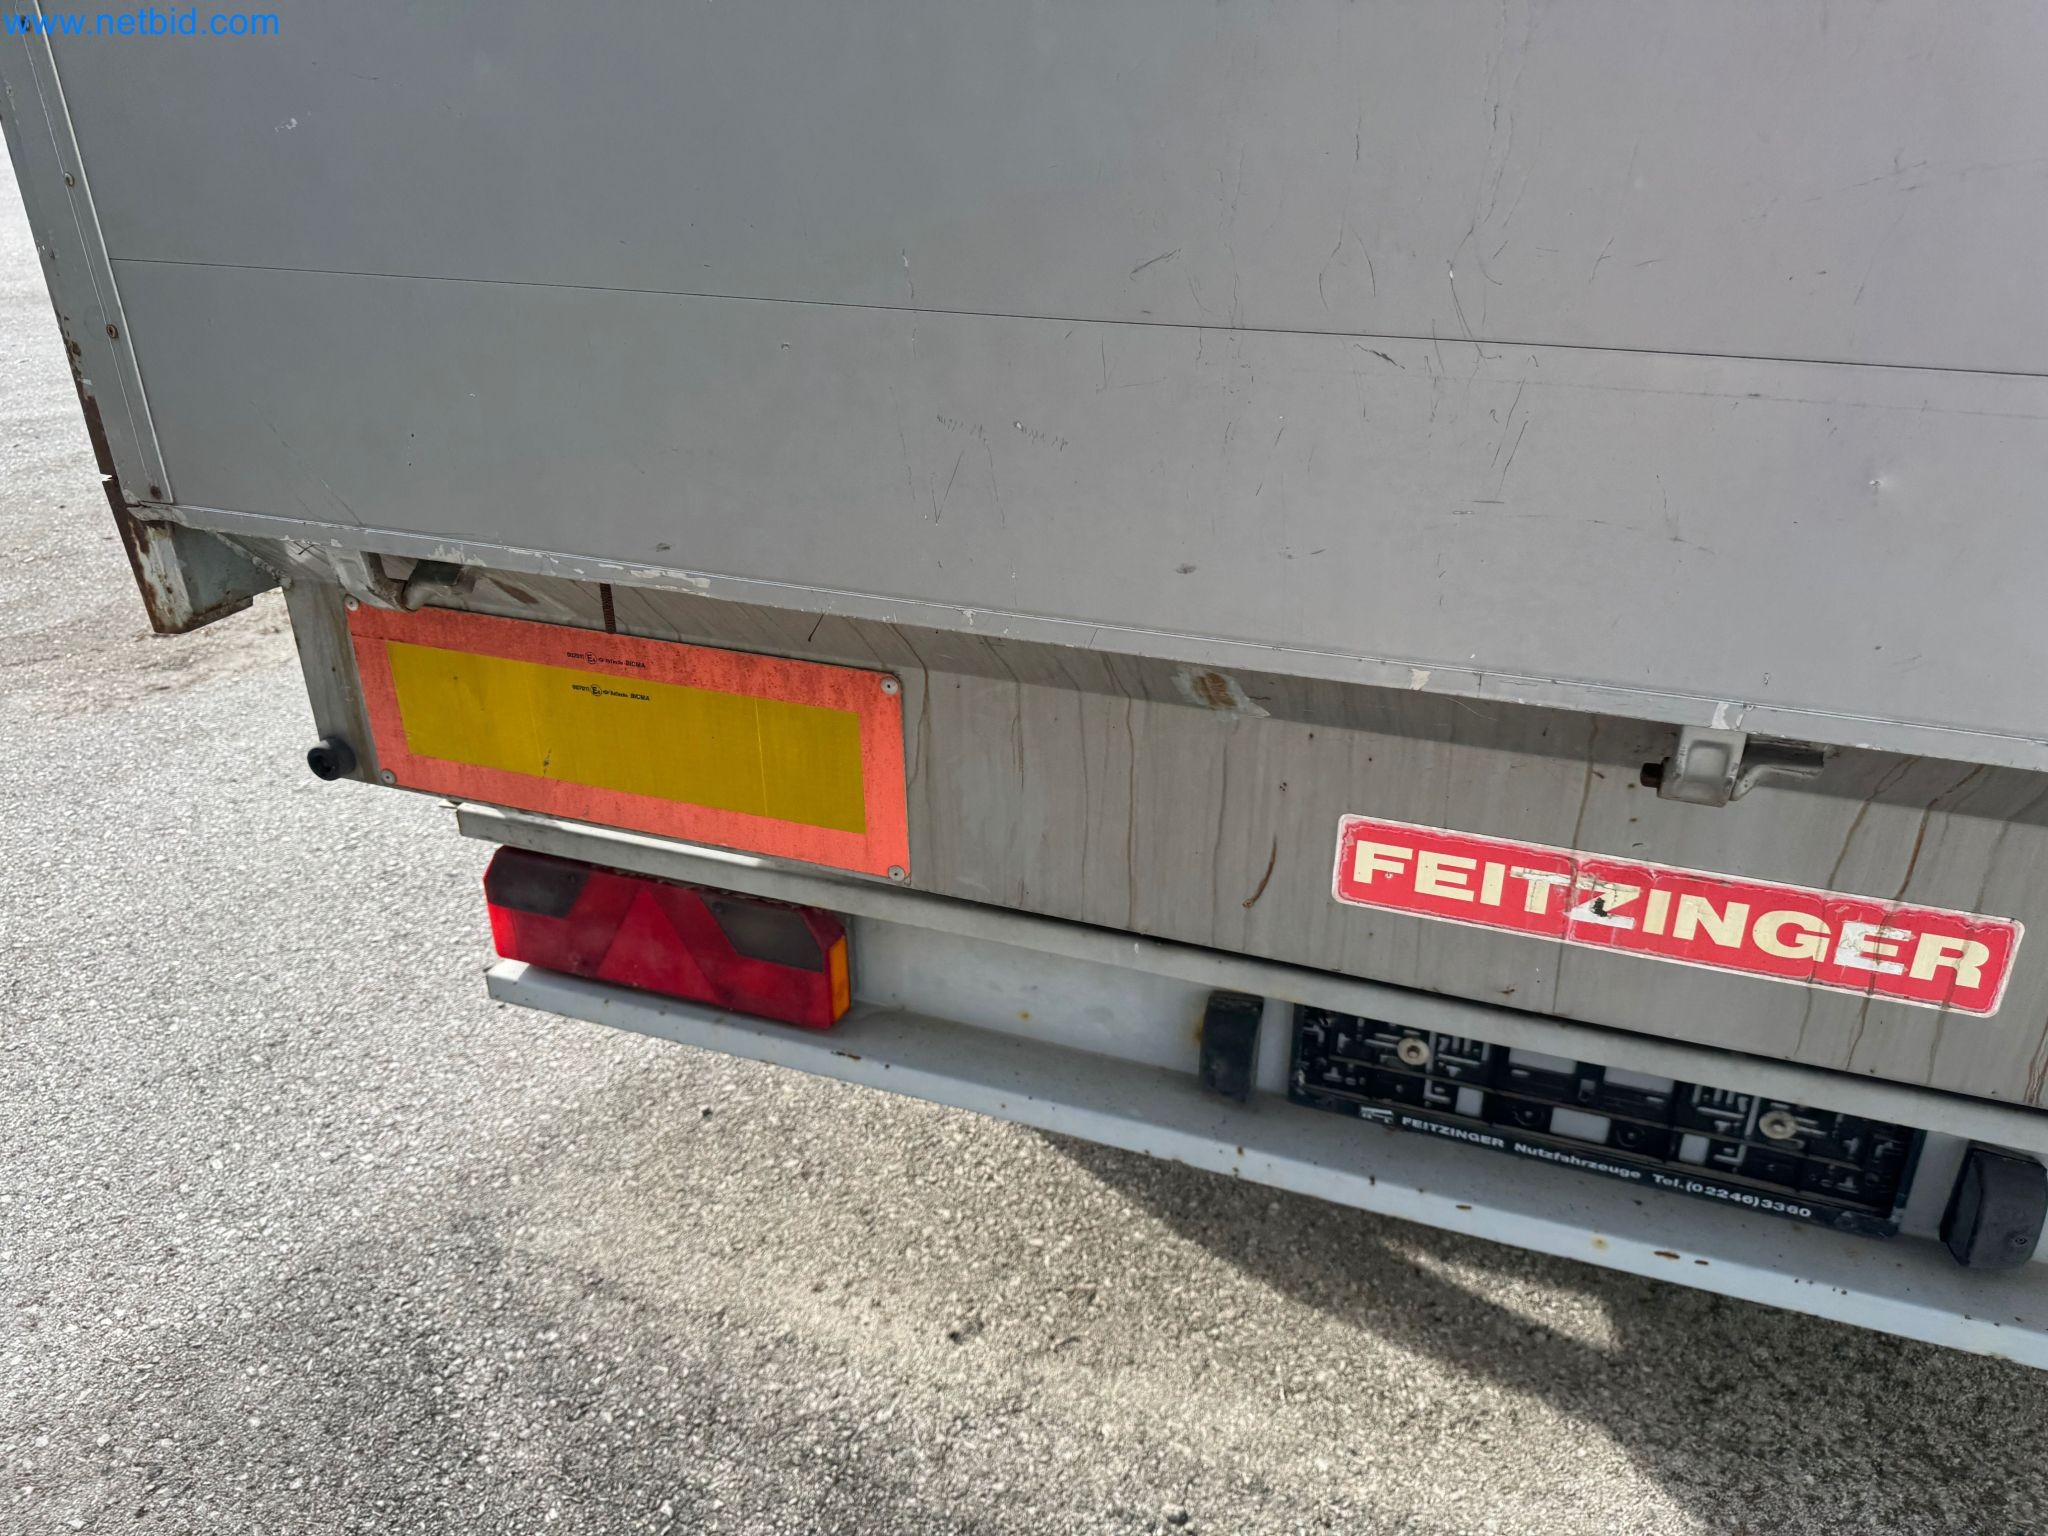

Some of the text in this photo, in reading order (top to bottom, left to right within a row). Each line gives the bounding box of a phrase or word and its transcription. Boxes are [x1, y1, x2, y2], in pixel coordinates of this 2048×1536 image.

[1352, 838, 1992, 989] FEITZINGER
[1401, 1116, 1505, 1149] FEITZINGER
[1514, 1142, 1642, 1179] Nutzfahrzeuge
